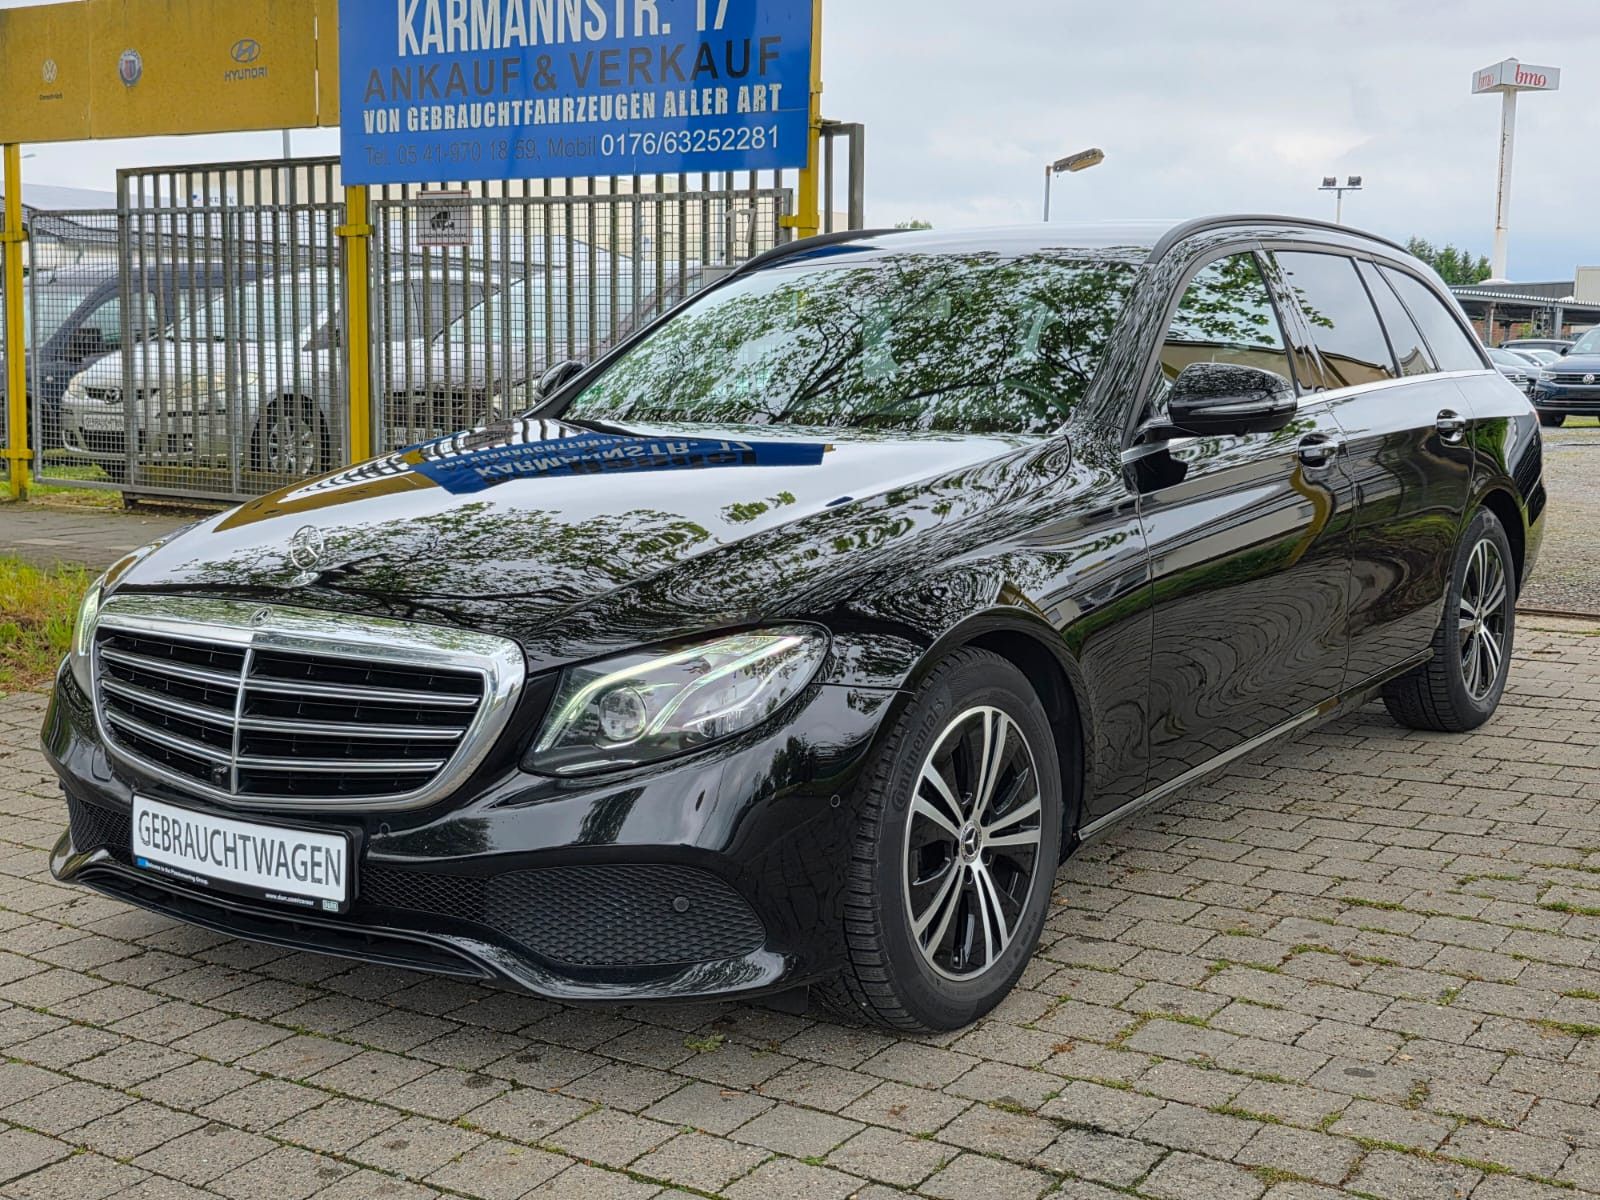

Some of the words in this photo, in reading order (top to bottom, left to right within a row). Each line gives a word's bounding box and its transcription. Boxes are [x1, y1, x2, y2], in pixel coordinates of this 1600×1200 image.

[398, 0, 671, 56] KARMANNSTR.
[364, 57, 521, 103] ANKAUF
[533, 54, 557, 92] &
[569, 36, 782, 89] VERKAUF
[364, 108, 400, 134] VON
[407, 92, 656, 132] GEBRAUCHTFAHRZEUGEN
[664, 87, 729, 118] ALLER
[737, 83, 782, 113] ART
[364, 146, 389, 166] Tel.
[547, 135, 597, 158] Mobil
[601, 125, 778, 156] 0176/63252281
[725, 207, 757, 243] 17
[138, 809, 342, 888] GEBRAUCHTWAGEN
